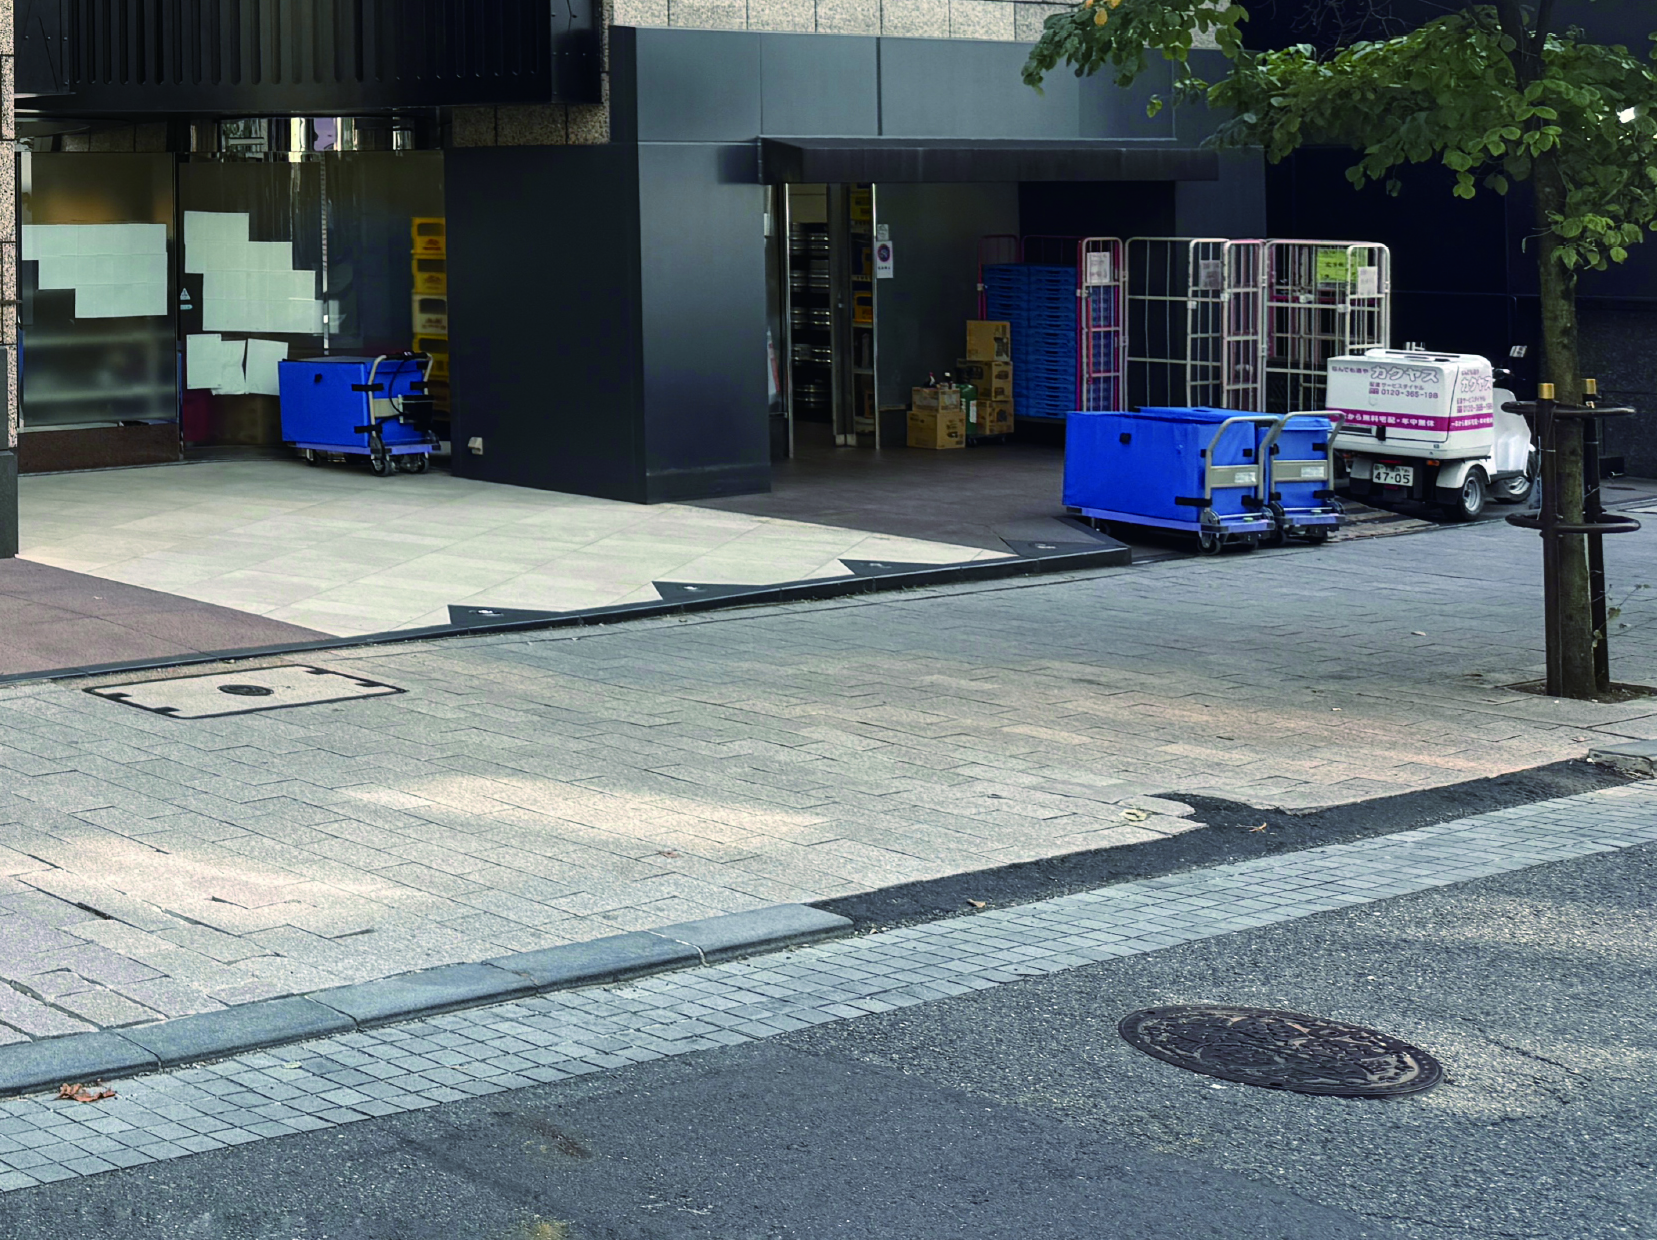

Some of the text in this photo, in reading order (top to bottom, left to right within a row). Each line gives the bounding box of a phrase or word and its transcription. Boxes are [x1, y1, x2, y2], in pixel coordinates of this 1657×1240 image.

[1370, 365, 1440, 384] カクヤス
[1344, 412, 1435, 427] から無料宅配・年中無休
